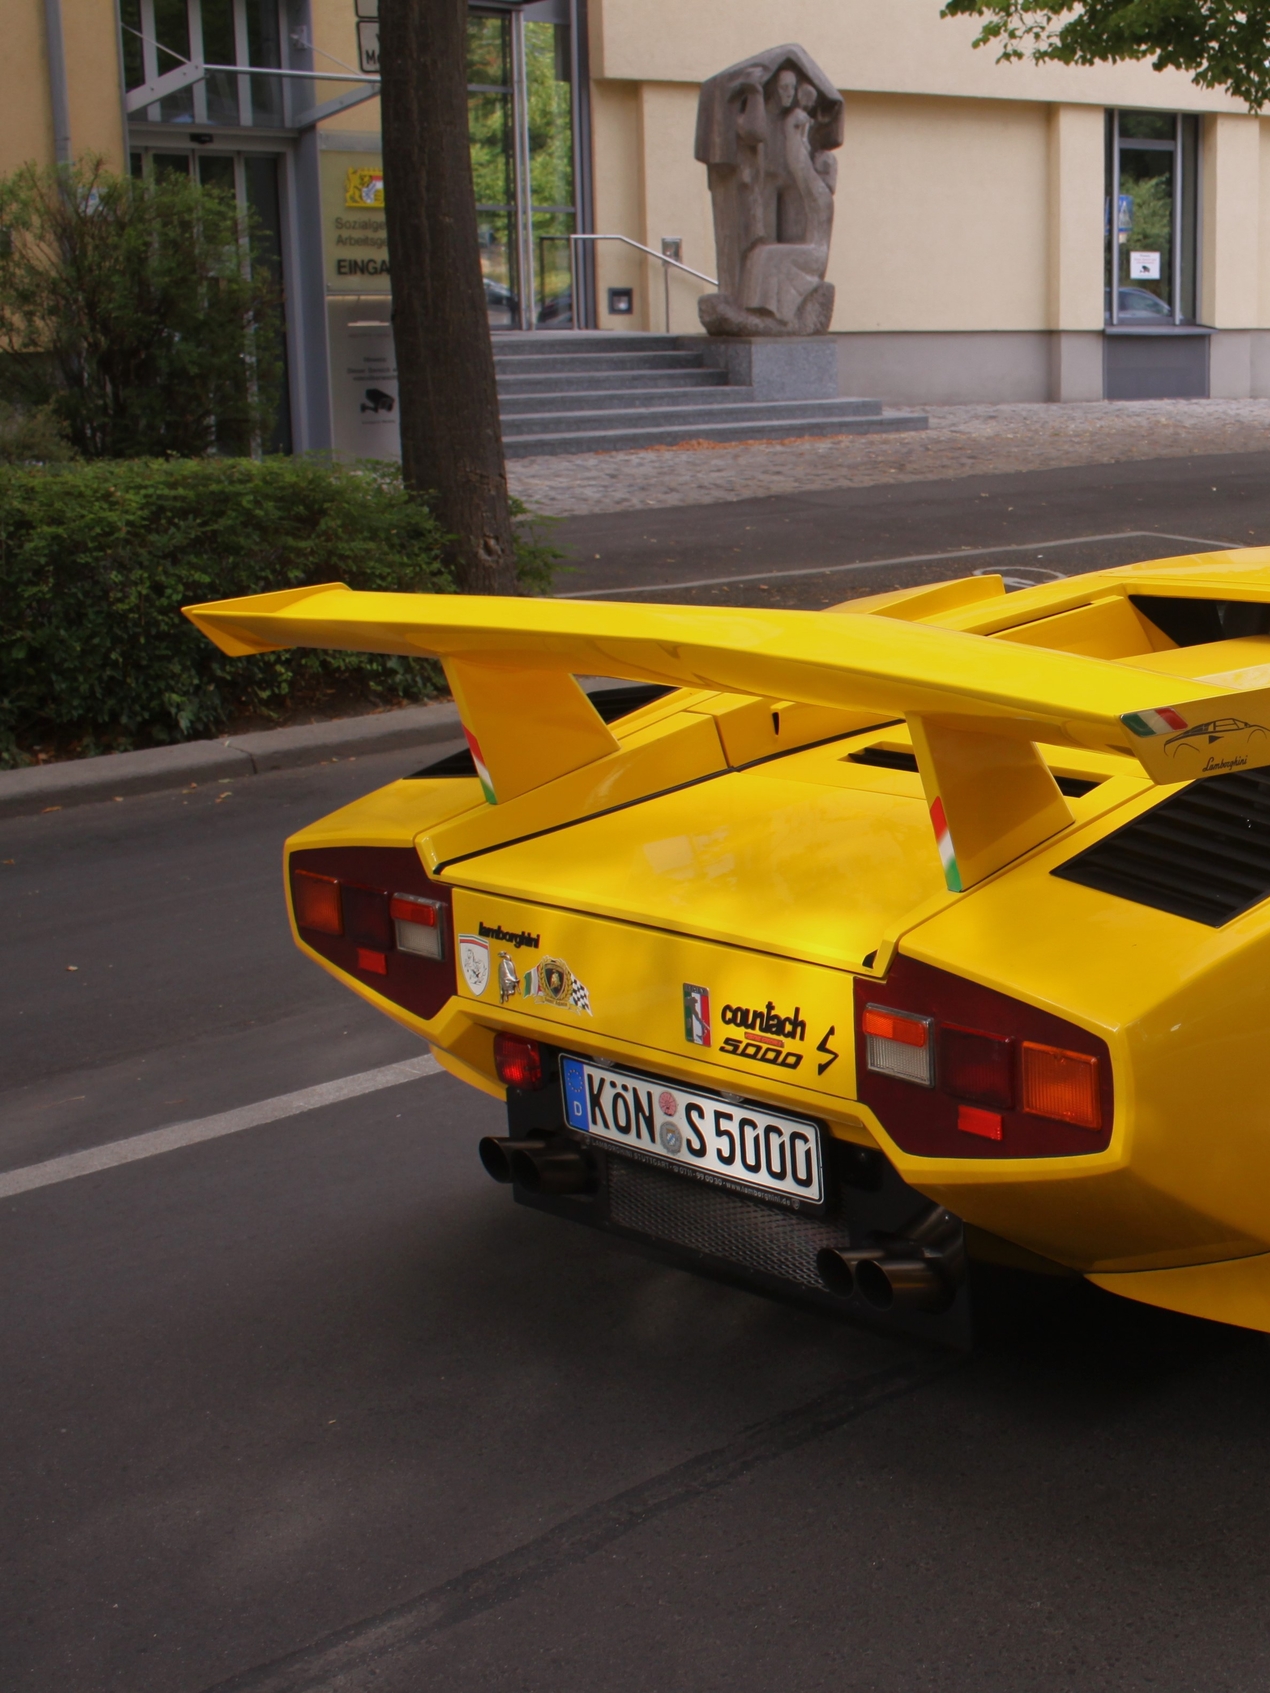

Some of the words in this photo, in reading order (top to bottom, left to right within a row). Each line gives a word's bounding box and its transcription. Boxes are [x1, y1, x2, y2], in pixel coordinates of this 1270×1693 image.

[1202, 755, 1249, 772] Lamborghini
[721, 1001, 807, 1042] countach
[719, 1036, 804, 1071] 5000
[574, 1101, 582, 1116] D
[587, 1073, 656, 1144] KÖN
